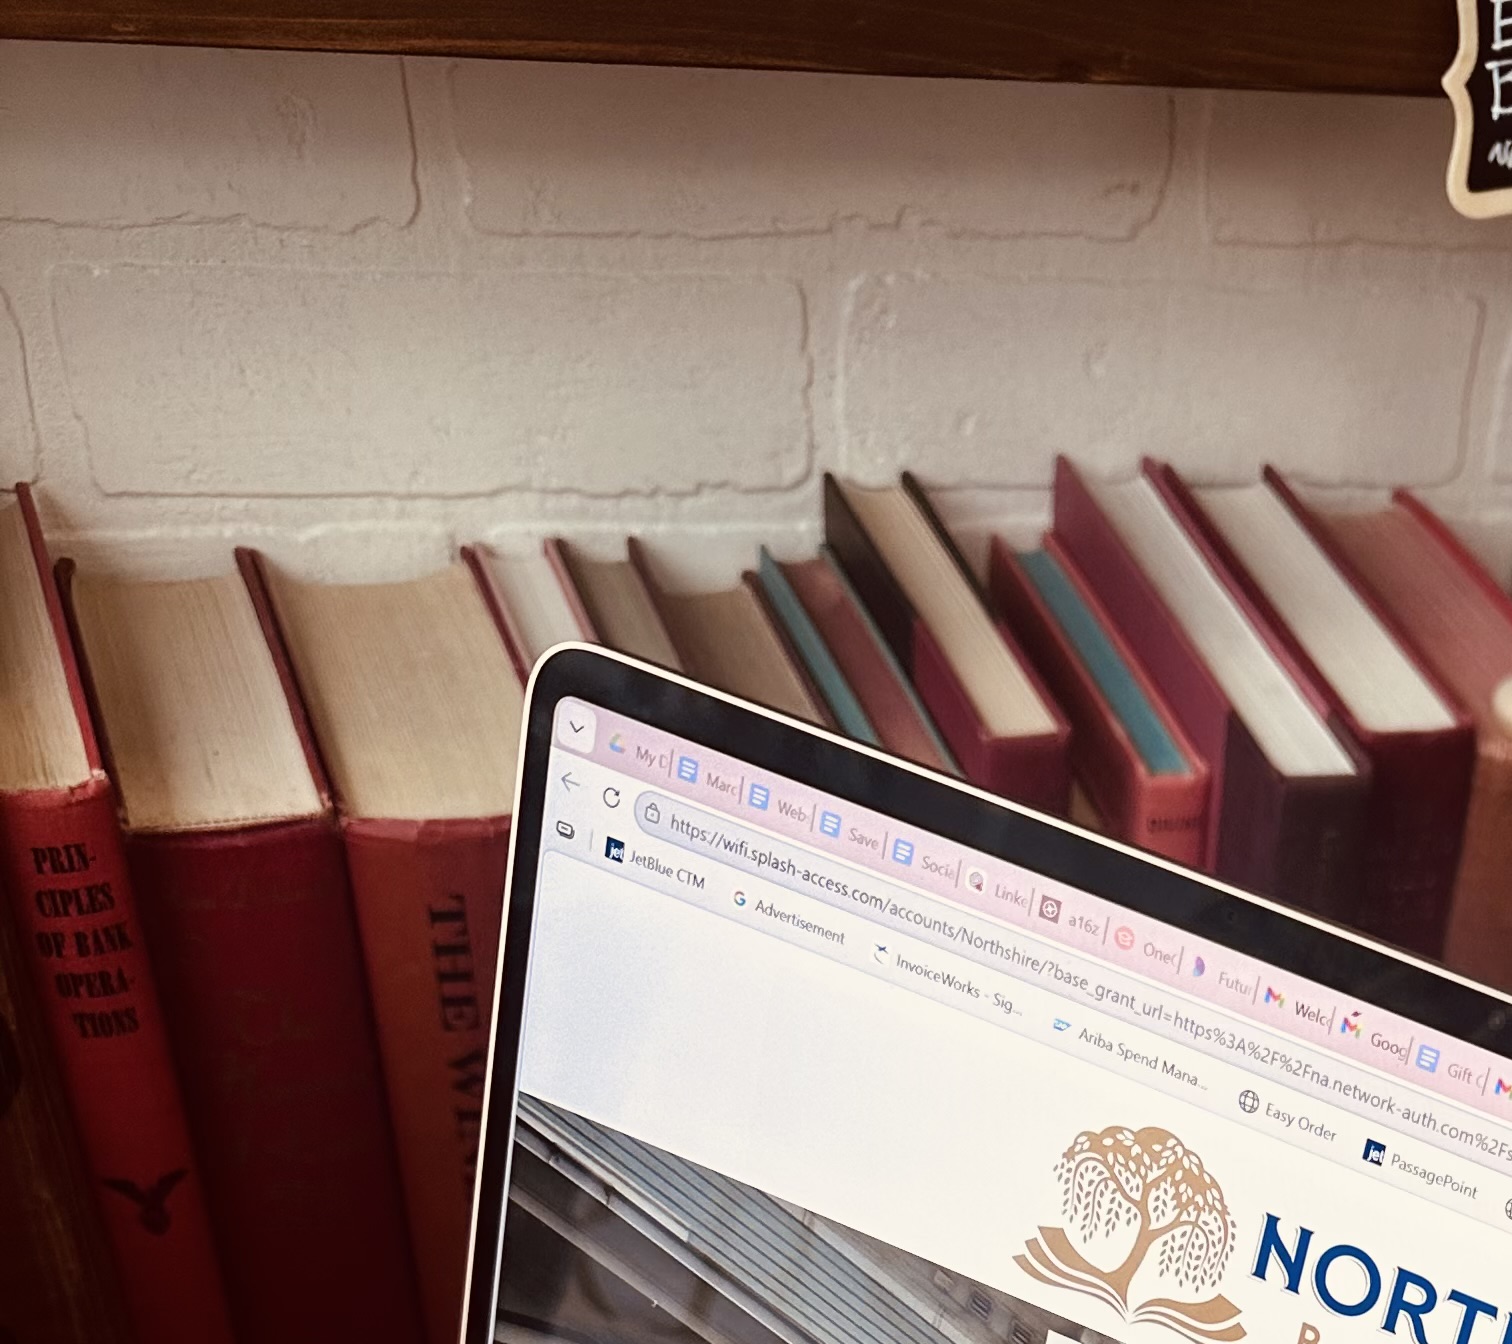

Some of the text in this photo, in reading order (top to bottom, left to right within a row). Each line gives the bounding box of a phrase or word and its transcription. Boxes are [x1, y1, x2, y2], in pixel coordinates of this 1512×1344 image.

[635, 746, 655, 766] My
[30, 843, 97, 875] PRIN-
[630, 851, 705, 890] JetBlue CTM
[36, 883, 115, 915] CIPLES
[37, 921, 133, 959] OF BANK
[756, 900, 845, 945] Advertisement
[1069, 914, 1101, 937] a16z
[427, 892, 482, 1032] THE
[896, 954, 981, 999] InvoiceWorks
[56, 968, 136, 998] OPERA-
[74, 1008, 139, 1040] TIONS
[1079, 1028, 1113, 1052] Ariba
[1117, 1043, 1159, 1069] Spend
[1447, 1064, 1472, 1086] Gift
[1265, 1103, 1337, 1141] Easy Order
[1391, 1154, 1478, 1199] PassagePoint
